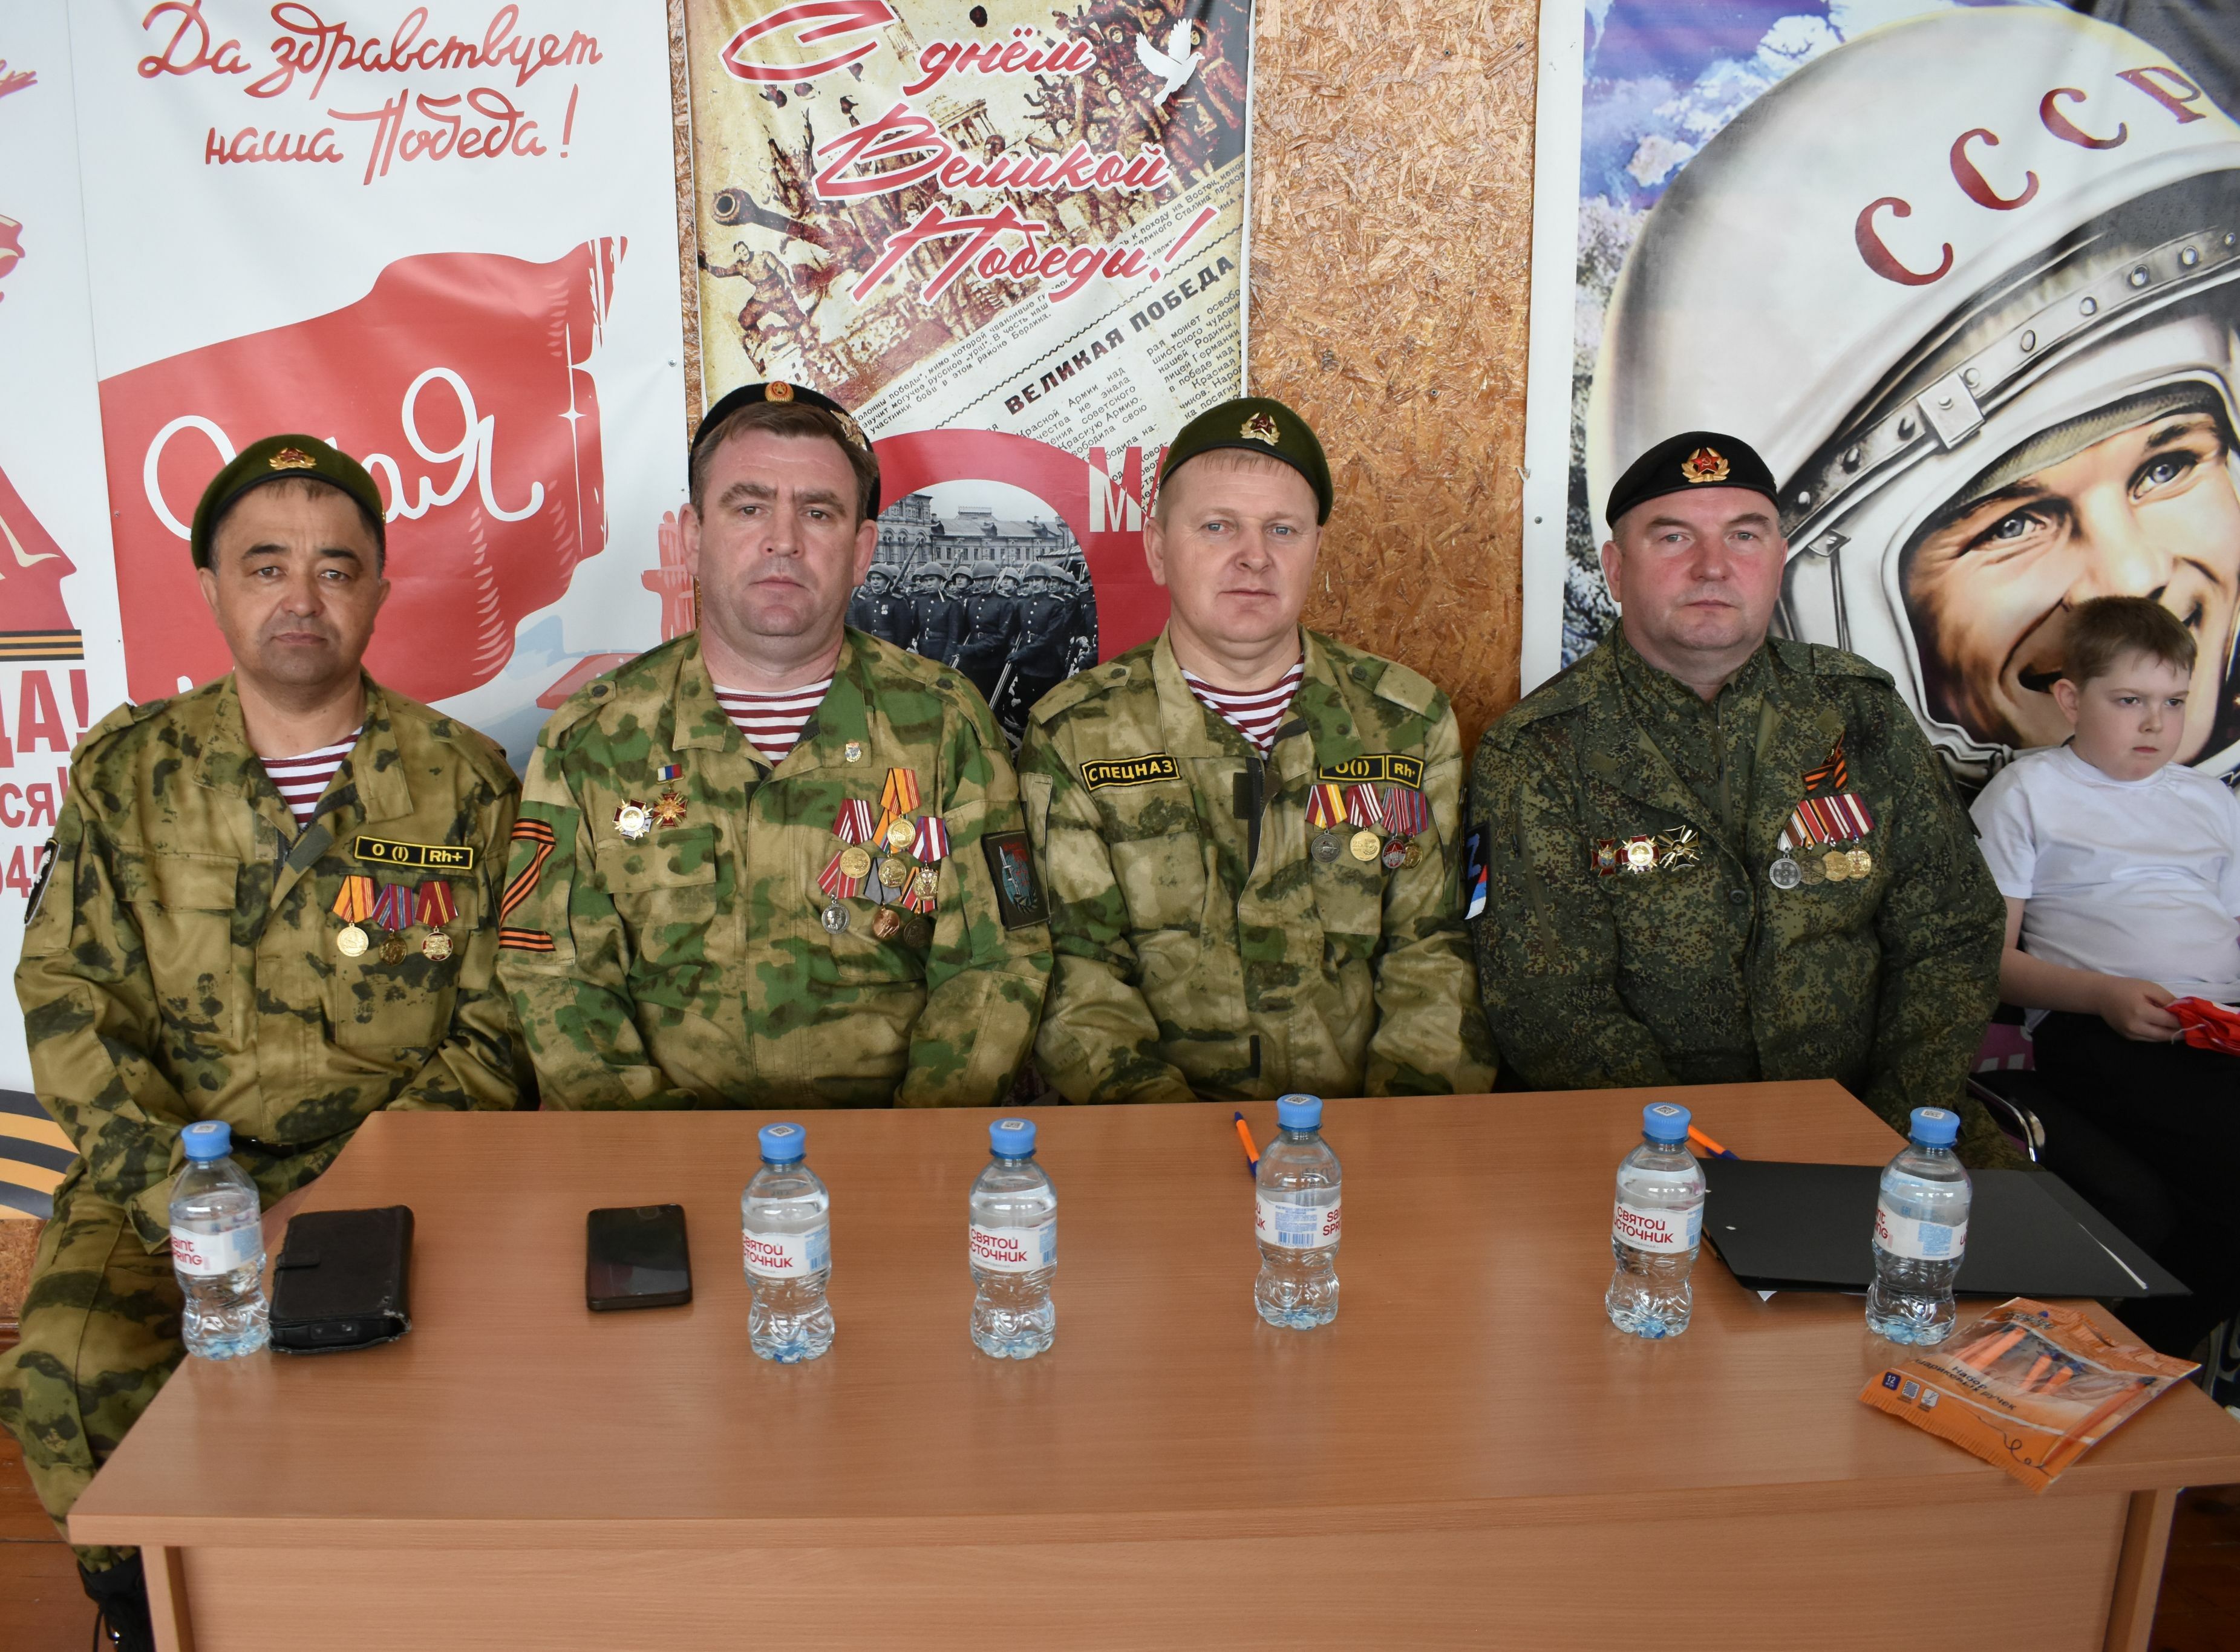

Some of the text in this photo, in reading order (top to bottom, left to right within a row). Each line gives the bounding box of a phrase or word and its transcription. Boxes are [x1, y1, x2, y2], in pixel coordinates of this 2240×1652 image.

[137, 0, 251, 79] Да
[243, 2, 603, 100] здравствует
[722, 0, 1091, 95] С днём
[206, 83, 579, 186] наша Победа!
[817, 103, 1169, 198] Великой
[1855, 66, 2207, 286] СССР
[852, 206, 1217, 304] Победы!
[1004, 256, 1235, 416] ВЕЛИКАЯ ПОБЕДА
[1147, 339, 1166, 357] рая
[1171, 315, 1200, 339] может
[1152, 328, 1203, 364] шистского
[1158, 320, 1236, 374] нашей Родины,
[928, 357, 949, 374] мимо
[1164, 360, 1191, 383] лицей
[1178, 361, 1212, 385] победе
[1216, 346, 1235, 361] над
[1192, 358, 1236, 389] Красная
[1068, 385, 1099, 408] Армии
[1107, 367, 1125, 382] над
[1079, 402, 1091, 413] не
[1101, 377, 1131, 398] знала
[1082, 386, 1135, 424] советского
[1122, 405, 1148, 423] свою
[1184, 409, 1197, 420] ка
[1089, 760, 1174, 782] СПЕЦНАЗ
[429, 850, 463, 862] Rh+
[1617, 1206, 1665, 1231] СВЯТОЙ
[744, 1236, 783, 1256] ВЯТОЙ
[970, 1241, 1028, 1262] СТОЧНИК
[971, 1229, 1018, 1250] СВЯТОЙ
[745, 1248, 793, 1268] ТОЧНИК
[1887, 1375, 1896, 1384] 12
[1952, 1365, 1987, 1390] Набор
[1980, 1391, 2017, 1411] ручек
